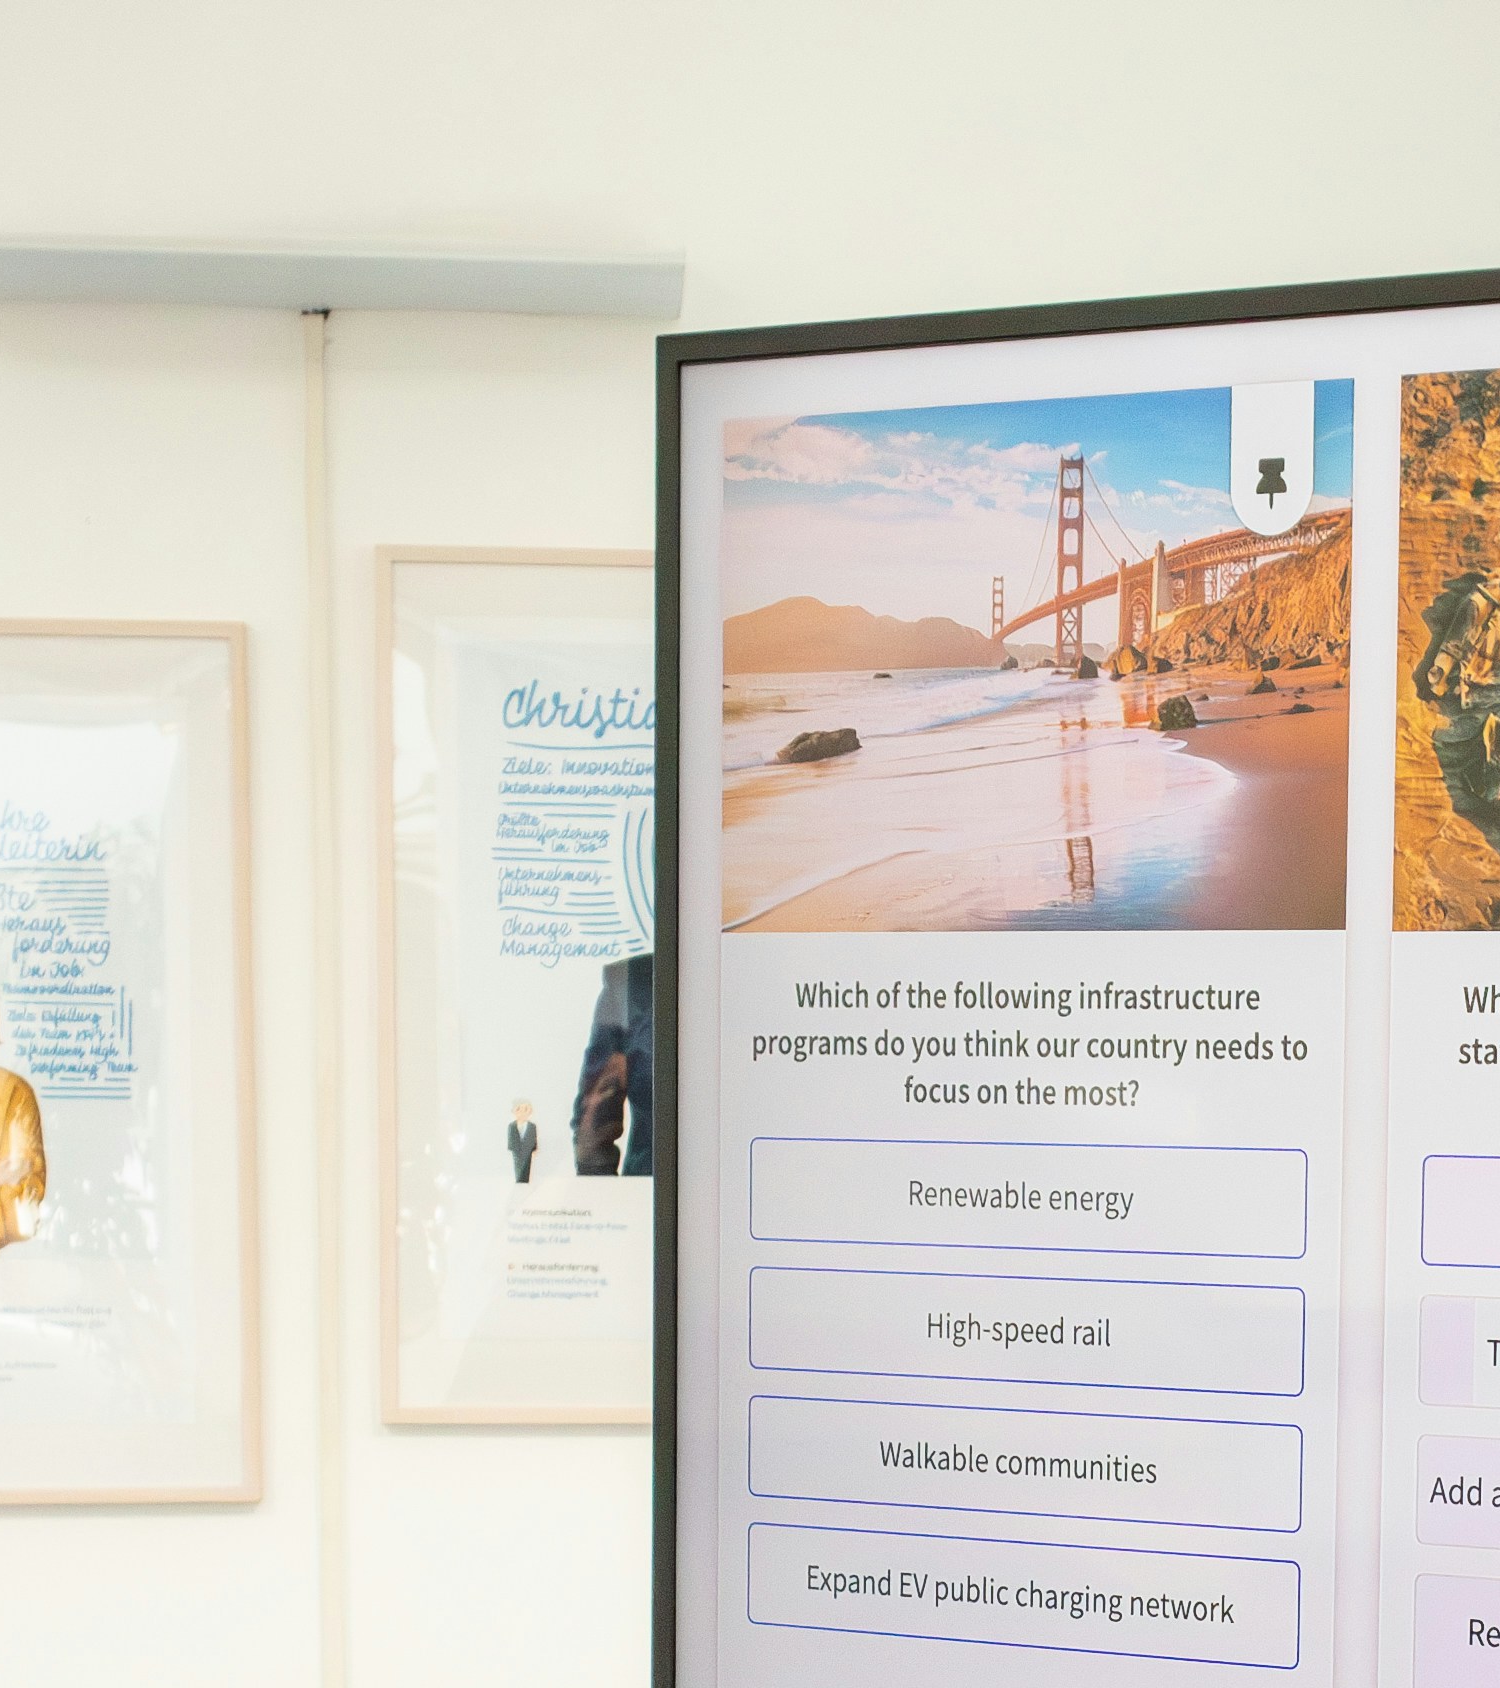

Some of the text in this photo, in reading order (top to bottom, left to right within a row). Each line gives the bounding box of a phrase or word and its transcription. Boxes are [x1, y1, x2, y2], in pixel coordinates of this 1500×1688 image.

[501, 914, 573, 944] Change
[499, 937, 622, 969] Management
[795, 980, 1261, 1018] Which of the following infrastructure
[752, 1028, 1308, 1067] programs do you think our country needs to
[903, 1074, 1140, 1107] focus on the most?
[909, 1180, 1134, 1220] Renewable energy
[927, 1312, 1111, 1350] High-speed rail
[879, 1440, 1157, 1484] Walkable communities
[1429, 1475, 1483, 1507] Add
[807, 1564, 1235, 1624] Expand EV public charging network
